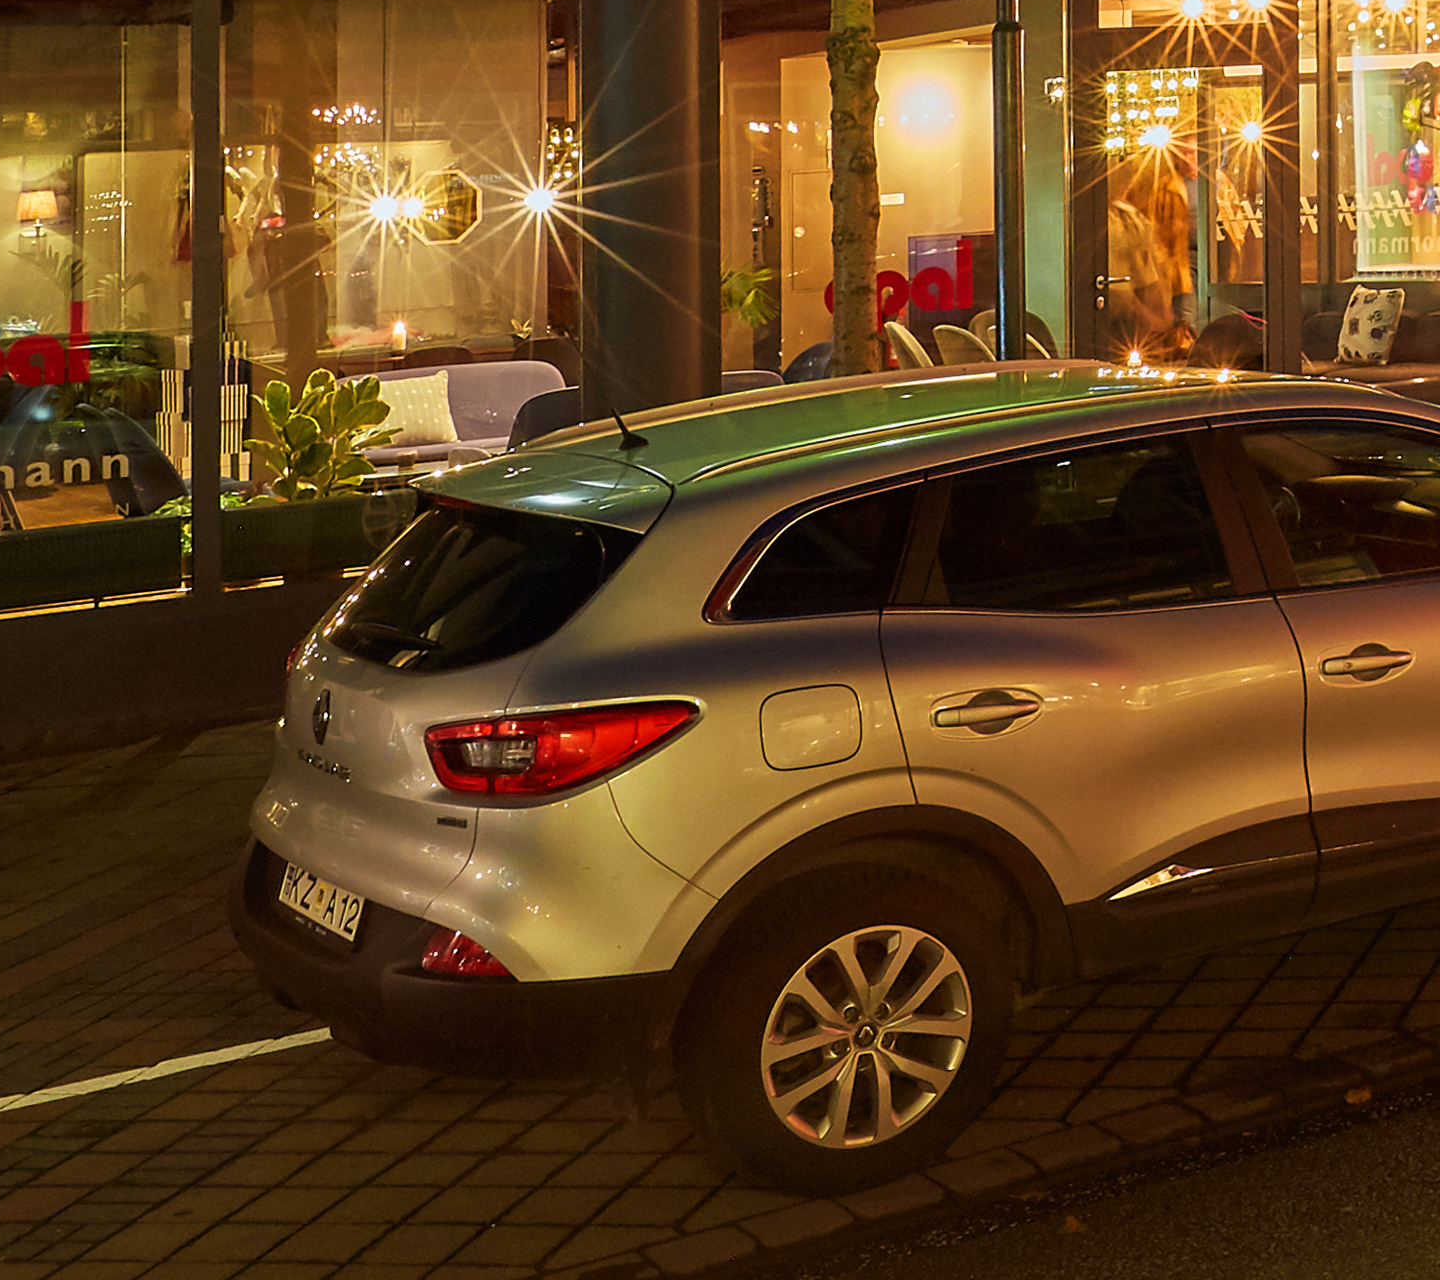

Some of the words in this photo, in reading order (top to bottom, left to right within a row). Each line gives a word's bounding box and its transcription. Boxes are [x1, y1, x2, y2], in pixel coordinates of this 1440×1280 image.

[825, 240, 973, 333] pal
[288, 867, 317, 910] KZ
[323, 888, 360, 934] A12
